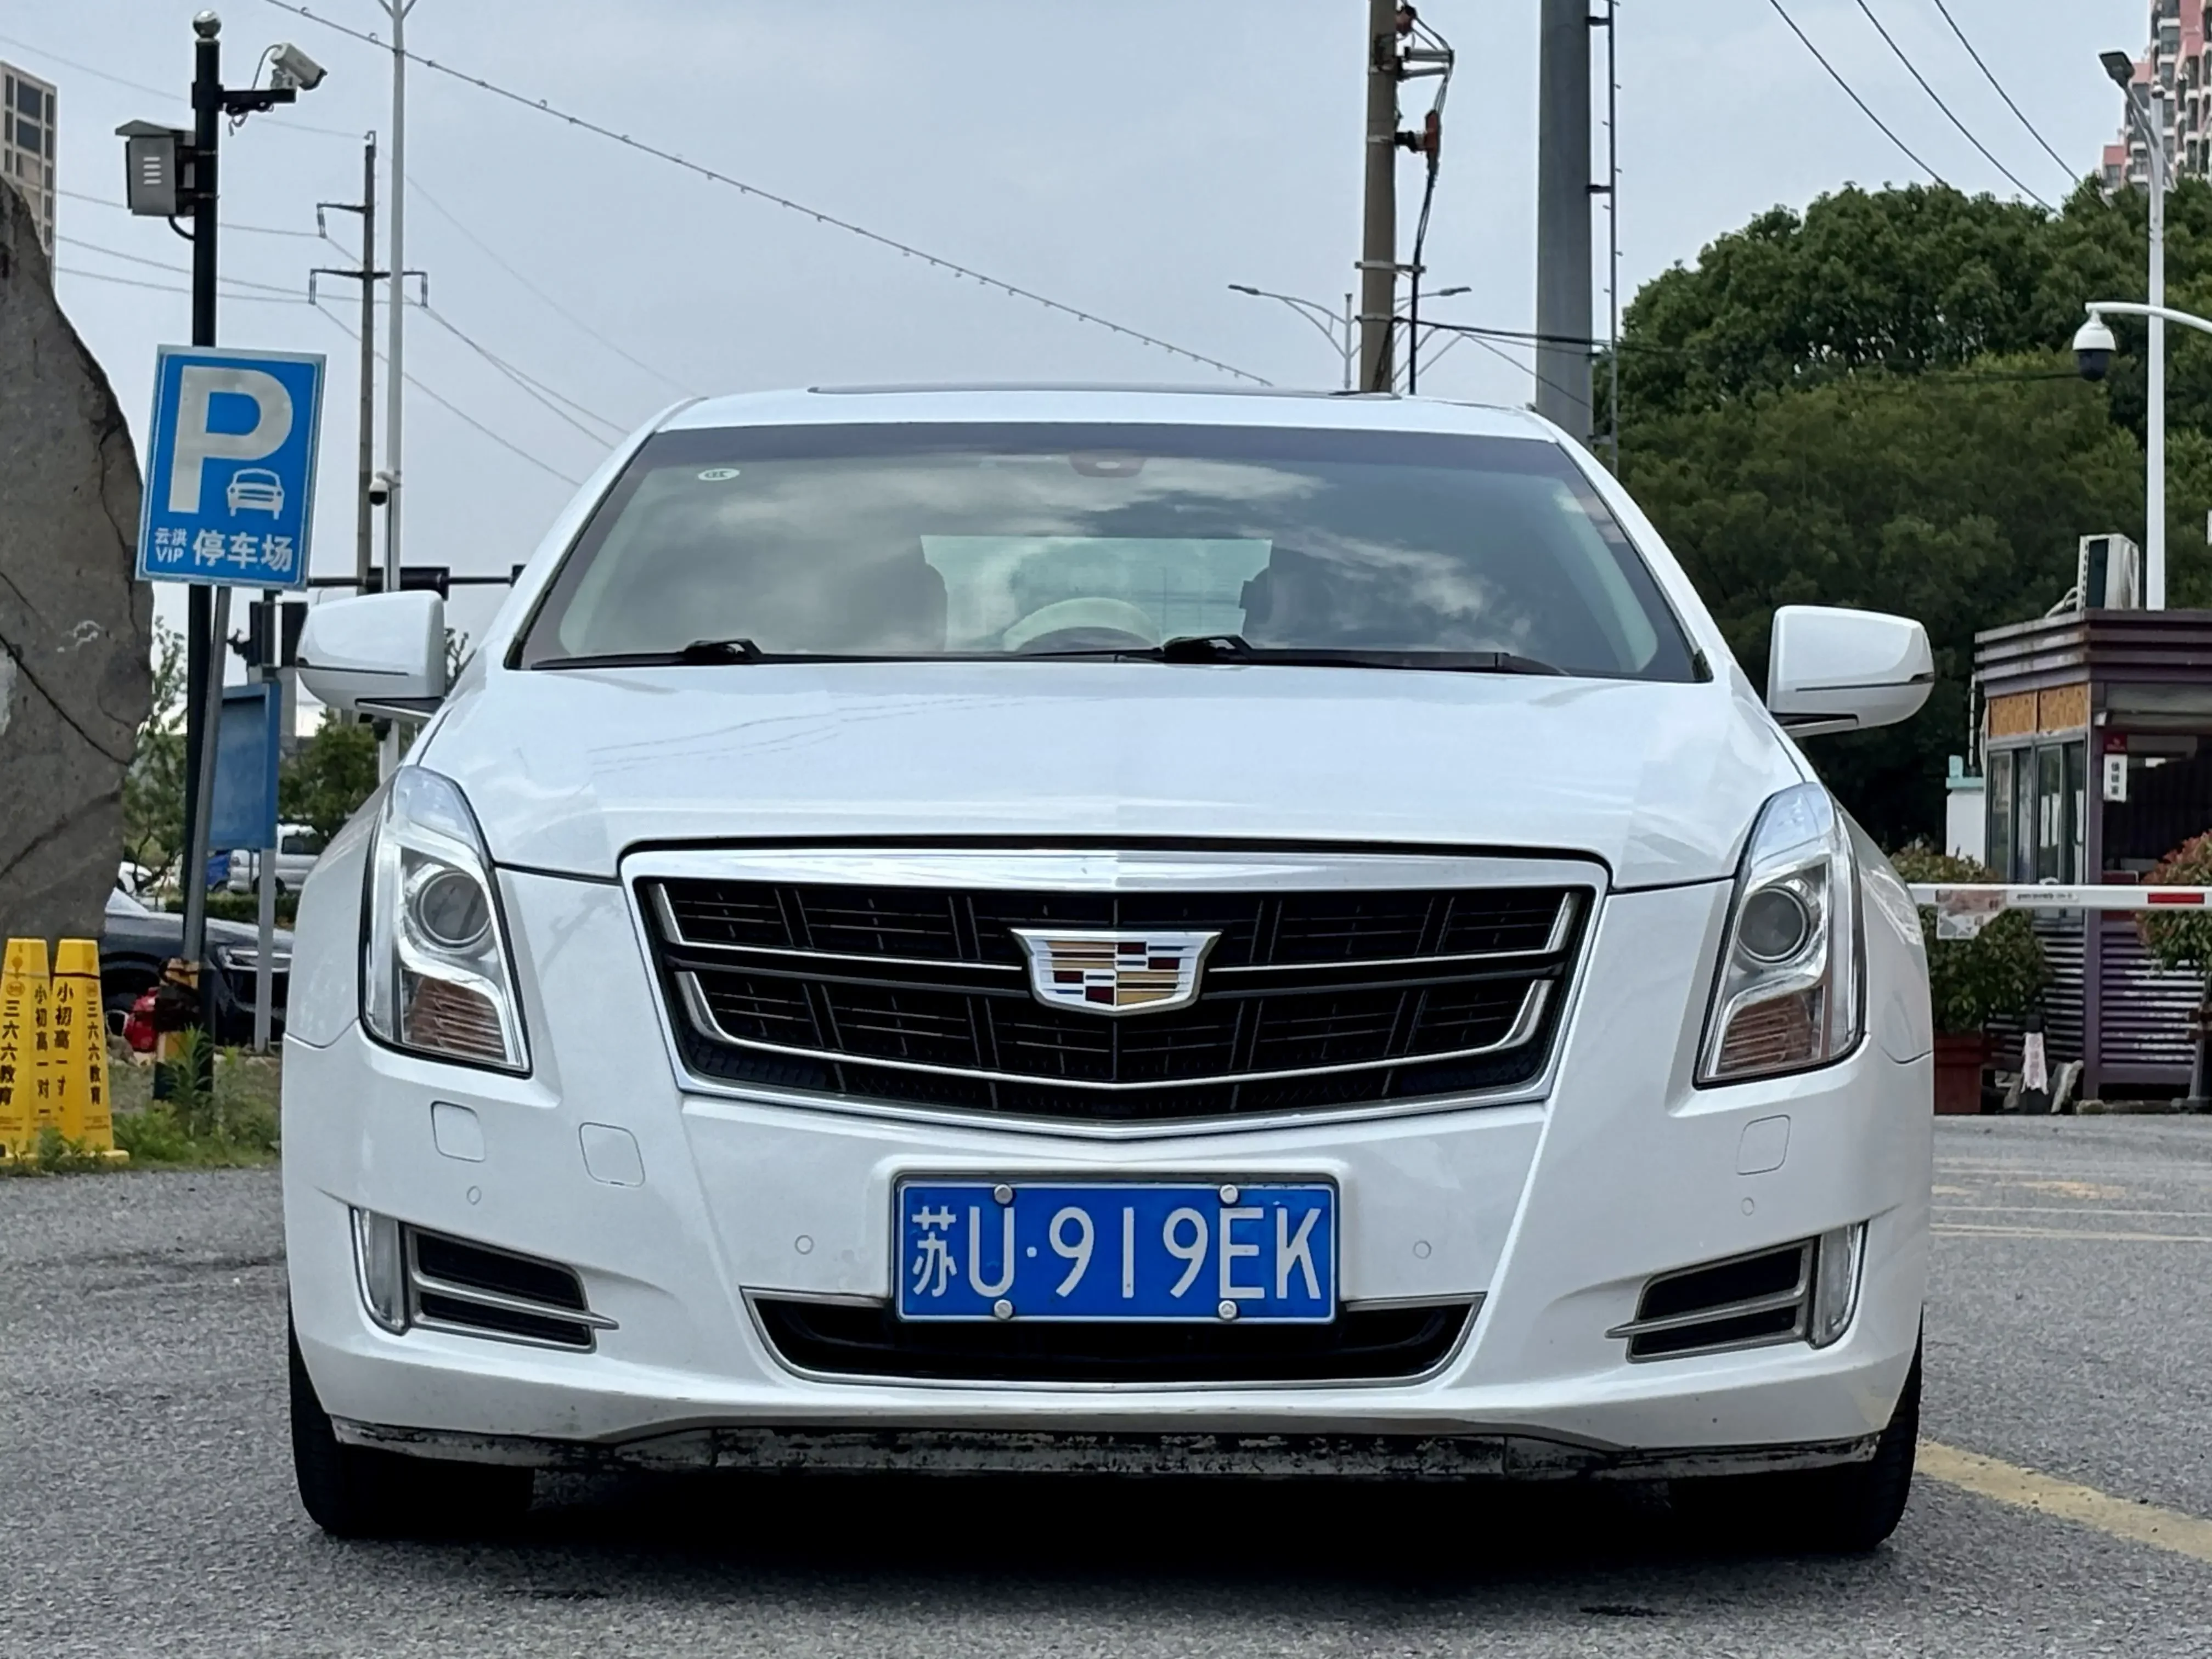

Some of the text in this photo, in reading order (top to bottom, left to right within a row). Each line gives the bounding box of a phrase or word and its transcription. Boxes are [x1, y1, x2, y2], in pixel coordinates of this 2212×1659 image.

[168, 364, 294, 514] P
[155, 545, 184, 563] VIP
[193, 528, 294, 573] 停车场
[34, 983, 51, 1115] 小初高一对一
[86, 1000, 102, 1106] 三六六教育
